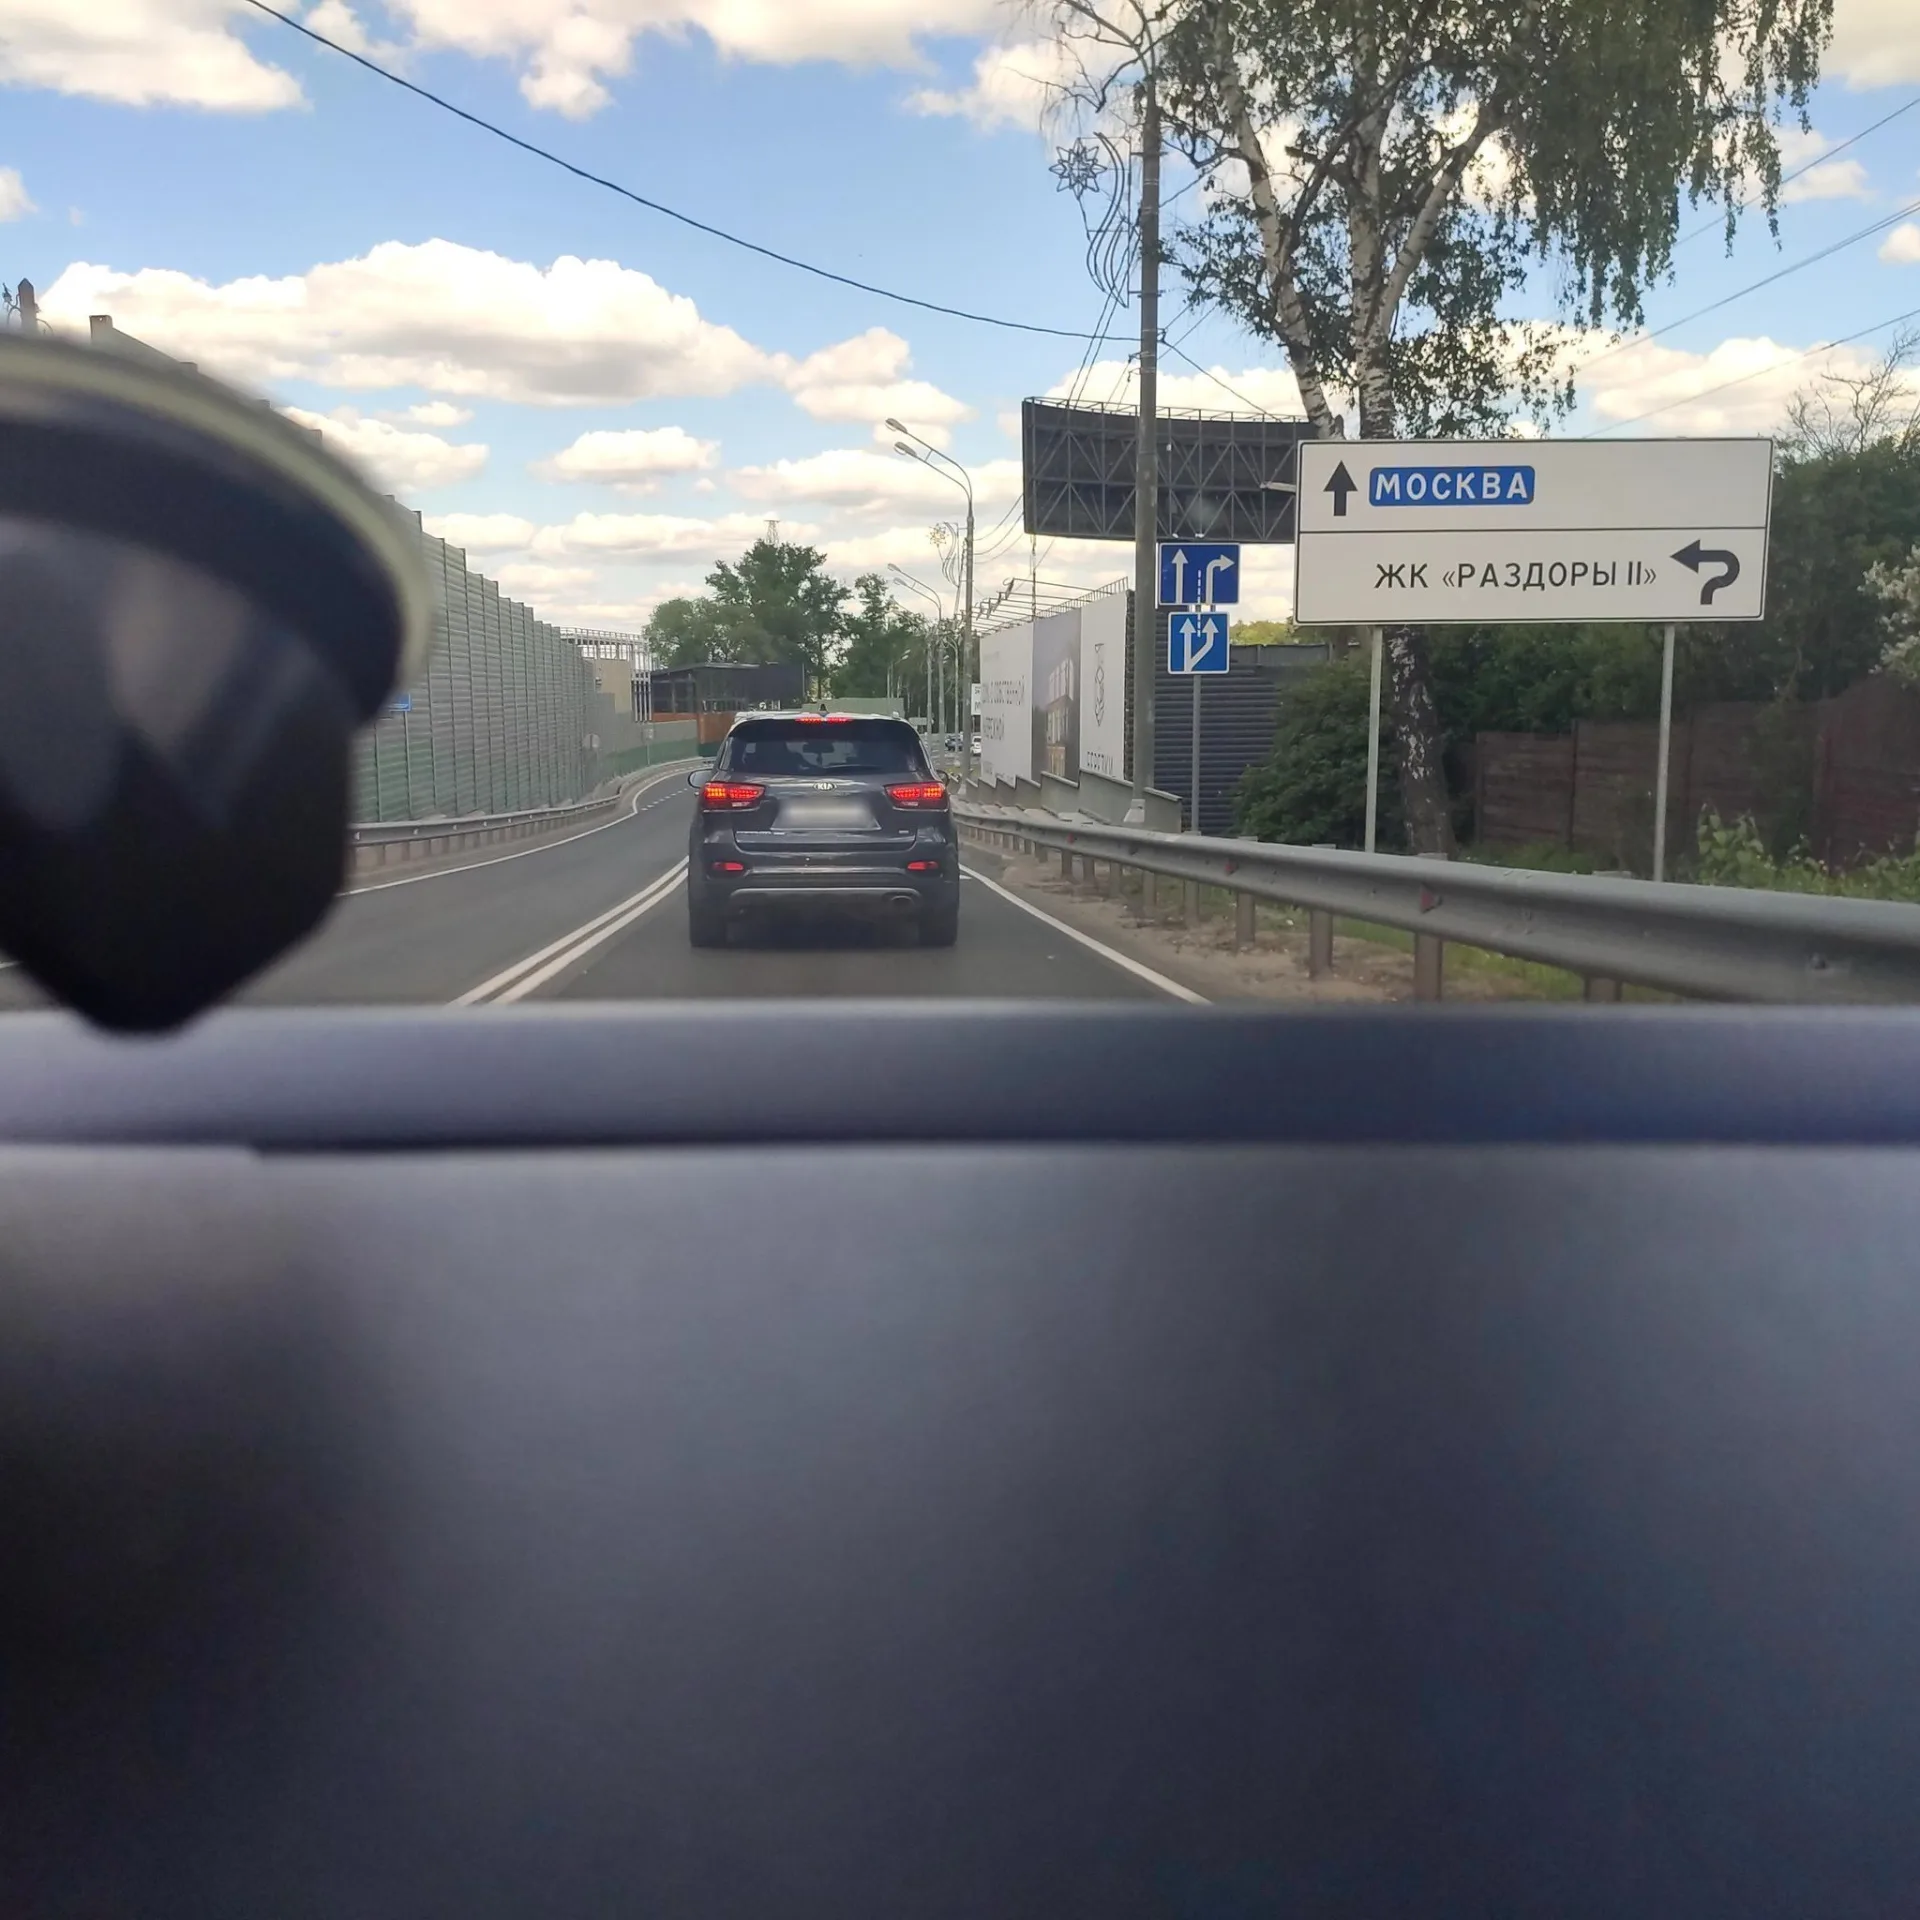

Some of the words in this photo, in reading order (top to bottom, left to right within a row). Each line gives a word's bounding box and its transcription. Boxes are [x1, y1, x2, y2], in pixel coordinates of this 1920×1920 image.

[1375, 472, 1528, 501] МОСКВА
[1373, 563, 1429, 589] ЖК
[1442, 561, 1617, 591] «РАЗДОРЫ
